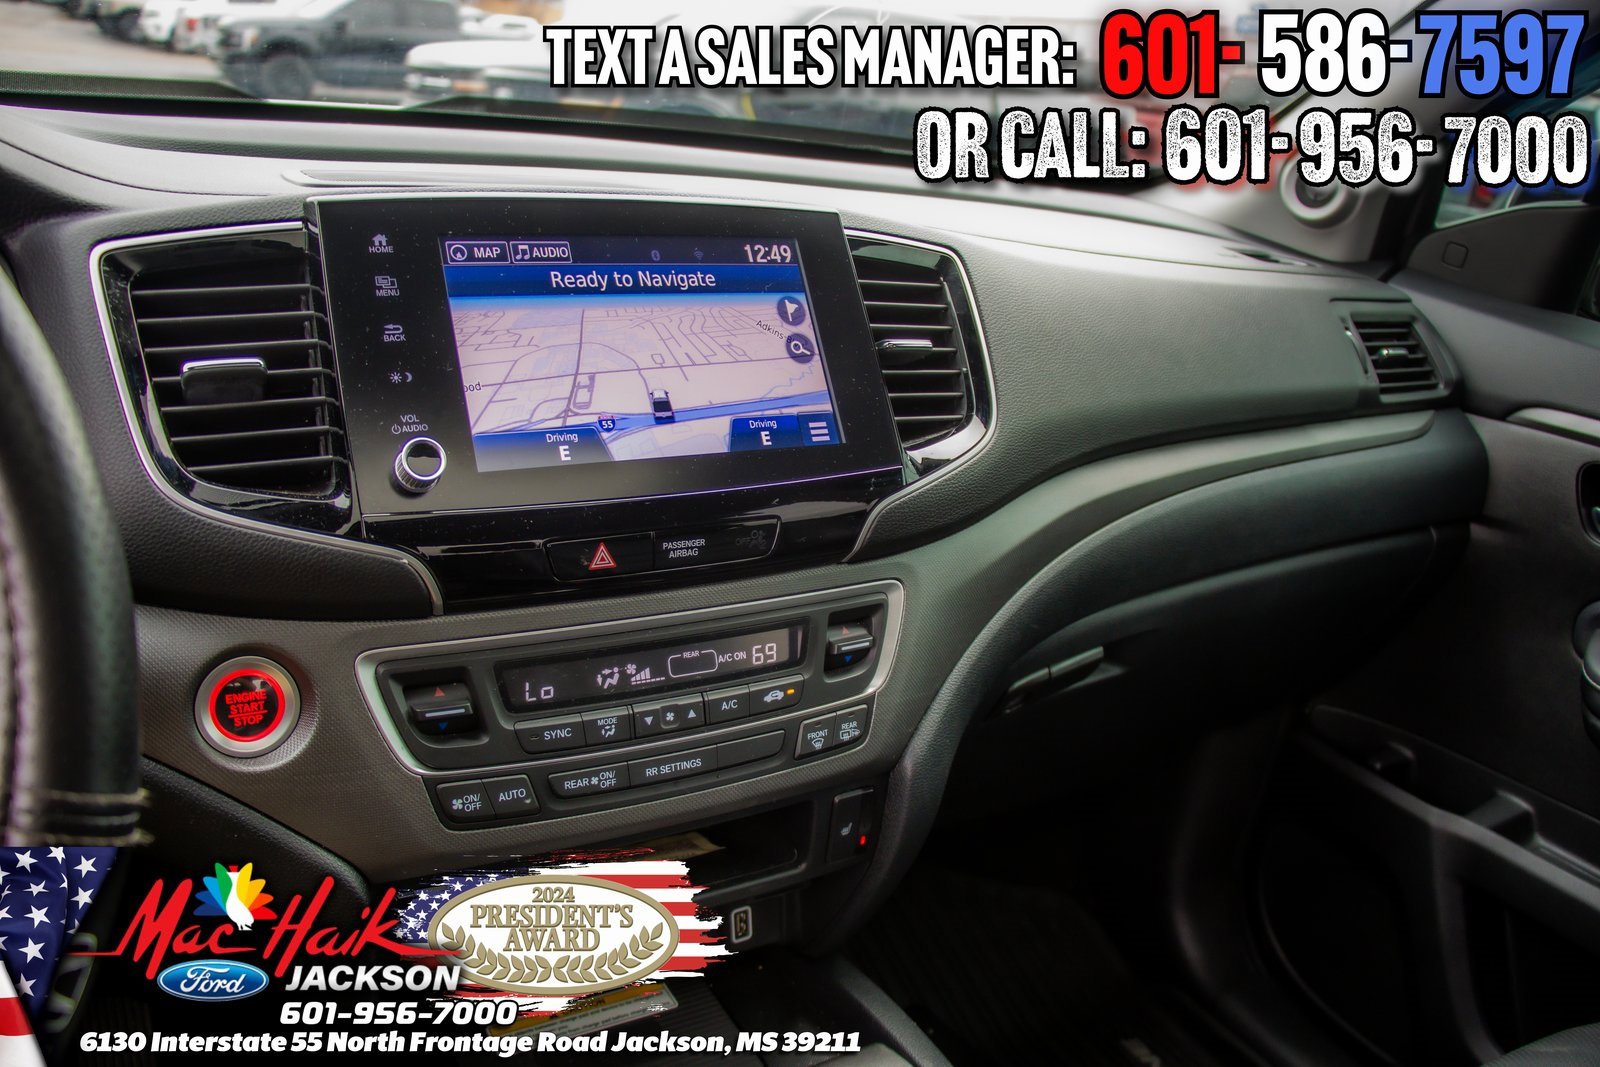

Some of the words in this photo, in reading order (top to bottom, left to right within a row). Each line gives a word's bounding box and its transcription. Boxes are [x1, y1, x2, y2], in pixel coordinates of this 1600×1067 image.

[368, 246, 394, 254] HOME
[473, 246, 501, 258] MAP
[531, 246, 569, 259] AUDIO
[744, 244, 792, 263] 12:49
[550, 270, 608, 290] Ready
[613, 272, 633, 287] to
[638, 271, 716, 291] Navigate
[375, 289, 400, 297] MENU
[756, 320, 784, 340] Adkins
[383, 334, 407, 342] BACK
[400, 415, 420, 423] VOL
[602, 419, 614, 429] 55
[749, 418, 778, 430] Driving
[401, 424, 429, 433] AUDIO
[546, 432, 579, 444] Driving
[760, 431, 773, 446] E
[559, 445, 571, 461] E
[662, 538, 706, 550] PASSENGER
[668, 548, 699, 559] AIRBAG
[683, 650, 700, 659] REAR
[718, 652, 733, 664] A/C
[733, 651, 747, 661] ON
[752, 643, 777, 665] 69
[225, 689, 267, 705] ENGINE
[525, 681, 554, 702] Lo
[230, 701, 265, 715] START
[721, 699, 738, 711] A/C
[234, 714, 264, 728] STOP
[597, 716, 618, 726] MODE
[841, 721, 858, 730] REAR
[544, 728, 572, 740] SYNC
[807, 729, 828, 741] FRONT
[646, 766, 659, 777] RR
[659, 758, 702, 775] SETTINGS
[599, 770, 616, 780] ON/
[564, 777, 590, 790] REAR
[600, 778, 617, 789] OFF
[463, 793, 481, 804] ON/
[498, 788, 527, 803] AUTO
[464, 802, 482, 812] OFF
